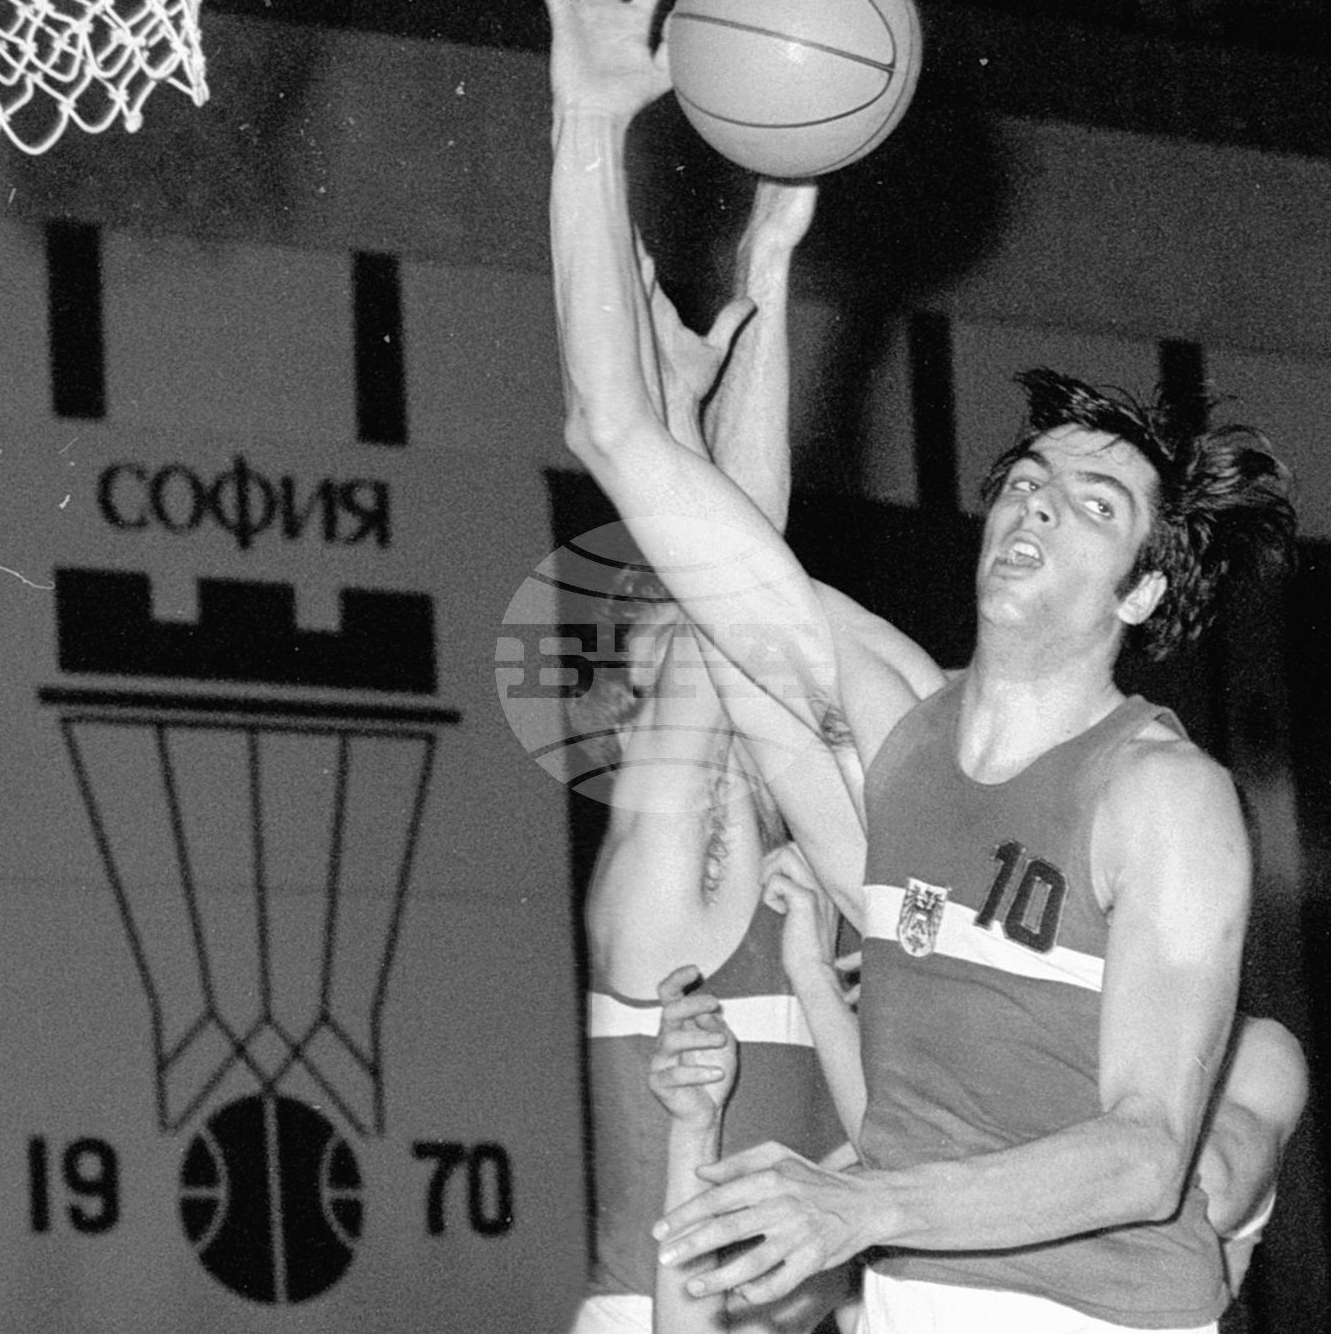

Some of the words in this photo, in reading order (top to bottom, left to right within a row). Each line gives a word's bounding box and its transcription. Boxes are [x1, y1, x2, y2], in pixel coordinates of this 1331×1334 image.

[96, 454, 392, 551] СОФИЯ
[973, 838, 1066, 955] 10
[27, 1135, 121, 1235] 19
[412, 1142, 515, 1237] 70
